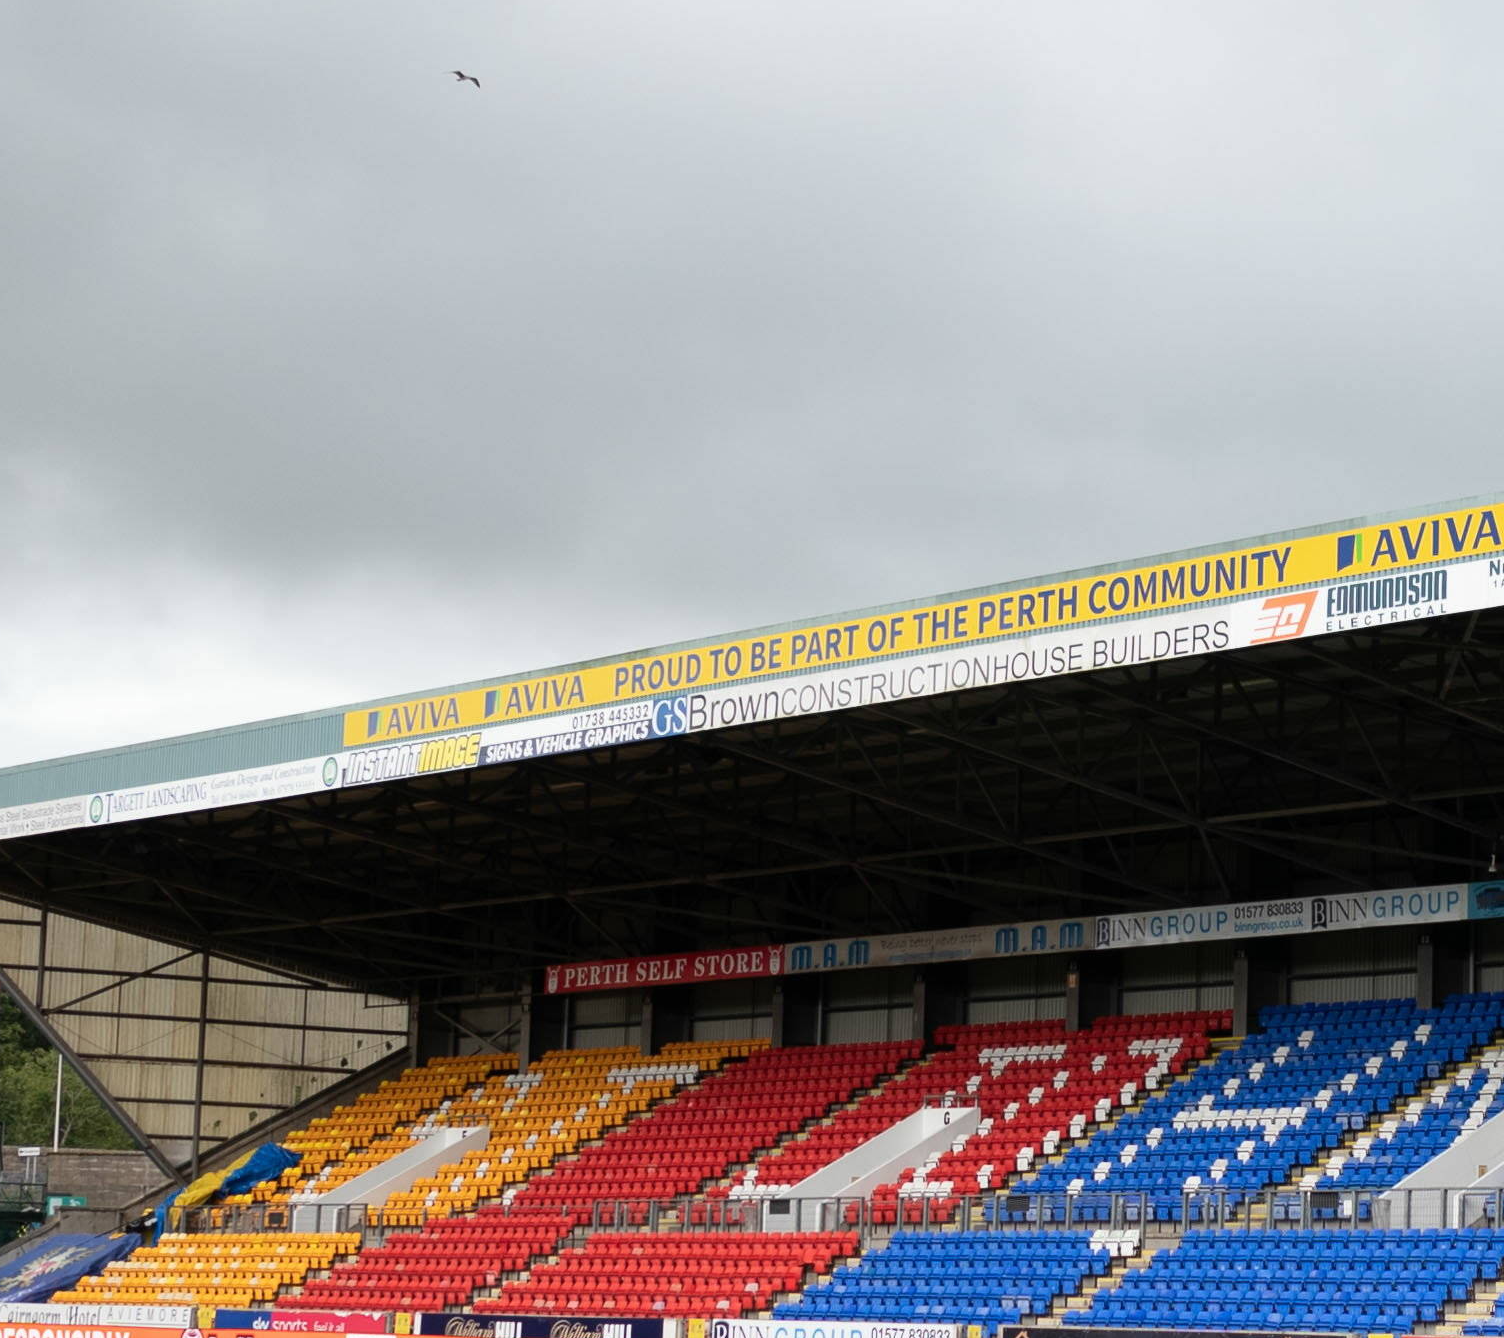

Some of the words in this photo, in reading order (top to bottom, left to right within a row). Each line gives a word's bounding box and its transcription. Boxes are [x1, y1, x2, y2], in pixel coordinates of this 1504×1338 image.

[1326, 570, 1447, 618] EDMUNDSON
[386, 698, 460, 737] AVIVA
[505, 675, 585, 716] AVIVA
[614, 653, 701, 697] PROUD
[709, 645, 742, 679] TO
[751, 637, 782, 671] BE
[790, 625, 860, 665] PART
[867, 617, 905, 654] OF
[914, 605, 968, 644] THE
[978, 585, 1078, 633] PERTH
[1087, 547, 1292, 615] COMMUNITY
[1371, 510, 1502, 568] AVIVA
[1326, 603, 1447, 631] ELECTRICAL
[1093, 619, 1229, 668] BUILDERS
[572, 711, 605, 729] 01738
[608, 704, 650, 724] 445332
[652, 698, 687, 735] GS
[535, 731, 582, 757] VEHICLE
[584, 722, 649, 750] GRAPHICS
[147, 782, 206, 808] LANDSCAPING
[1096, 915, 1146, 947] BINN
[1151, 911, 1228, 938] GROUP
[1234, 905, 1264, 920] 01577
[1267, 902, 1304, 917] 830833
[1312, 897, 1368, 931] BINN
[1373, 890, 1460, 919] GROUP
[564, 965, 629, 989] PERTH
[636, 959, 687, 982] SELF
[694, 951, 764, 976] STORE
[107, 1308, 188, 1322] AVIEMORE
